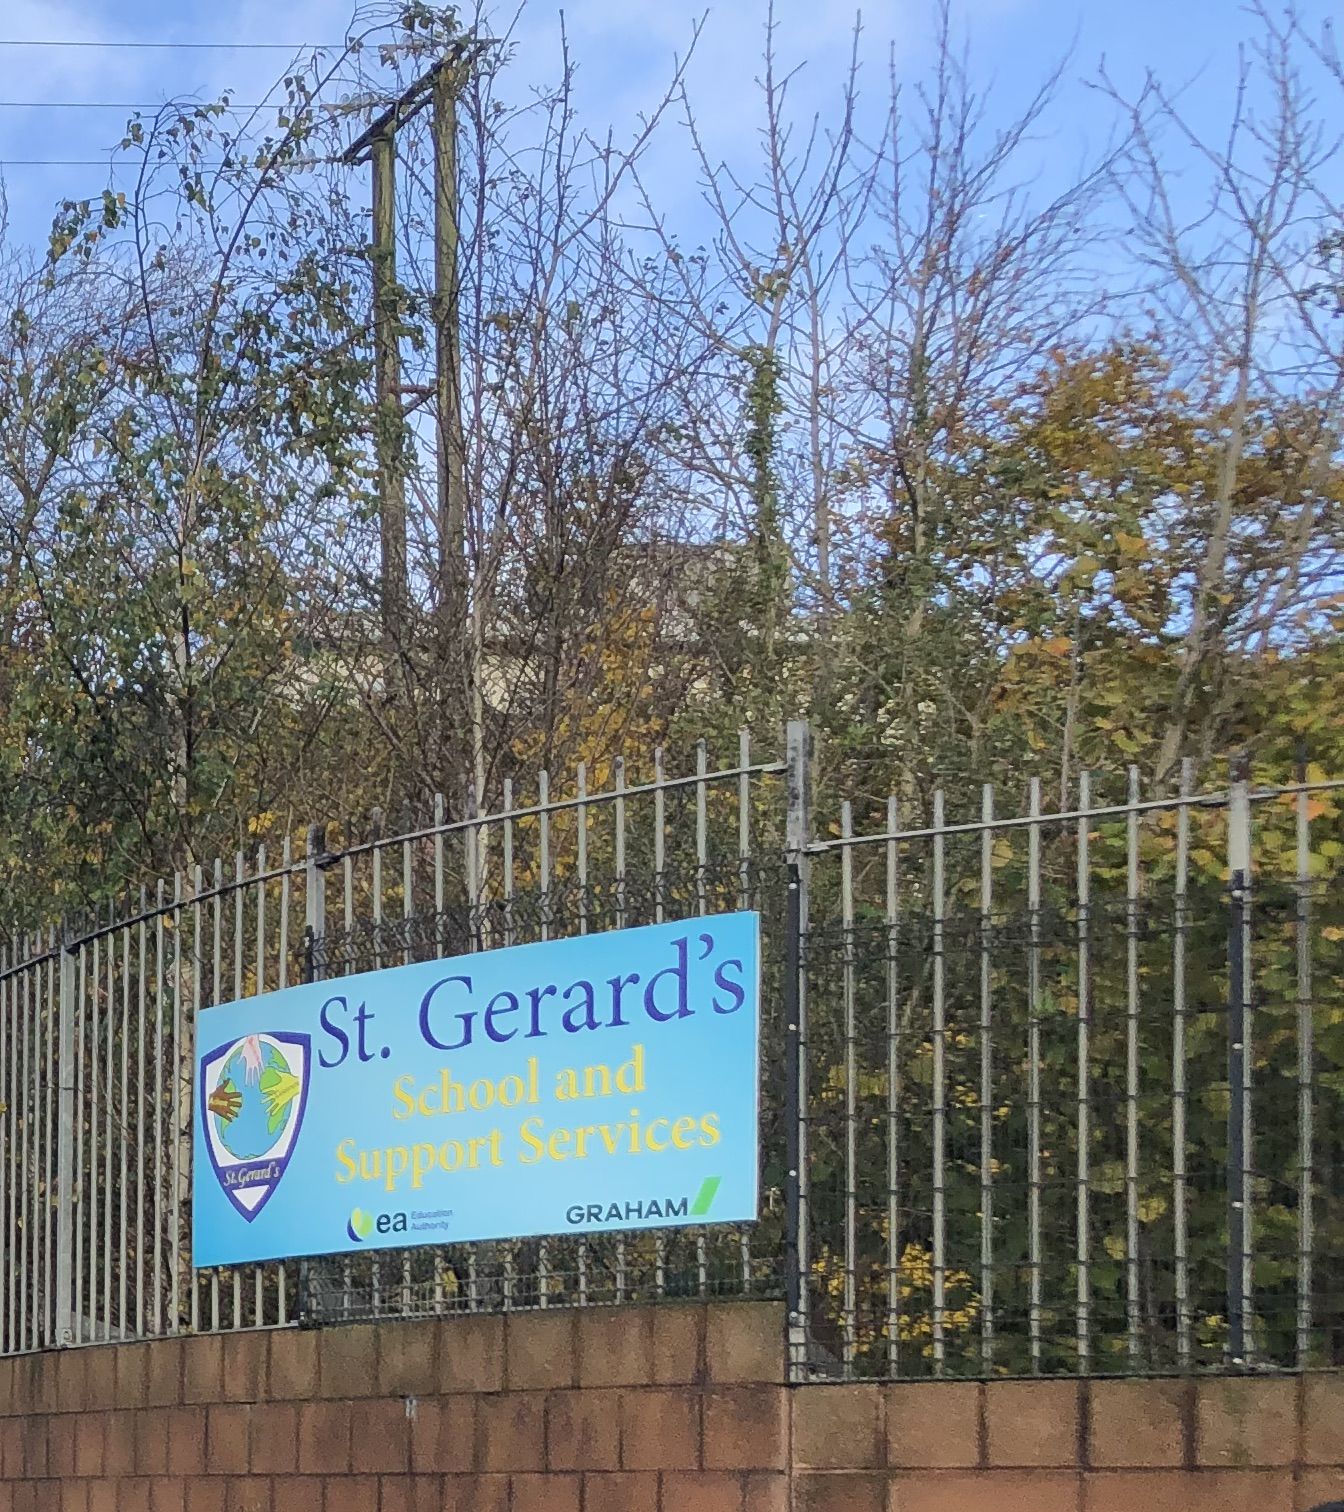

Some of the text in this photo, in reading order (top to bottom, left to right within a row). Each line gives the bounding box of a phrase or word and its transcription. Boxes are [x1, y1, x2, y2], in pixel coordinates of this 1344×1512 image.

[318, 933, 746, 1068] St. Gerard's
[392, 1043, 647, 1121] School and
[335, 1107, 722, 1191] Support Services
[375, 1210, 408, 1235] ea
[565, 1196, 689, 1226] GRAHAM
